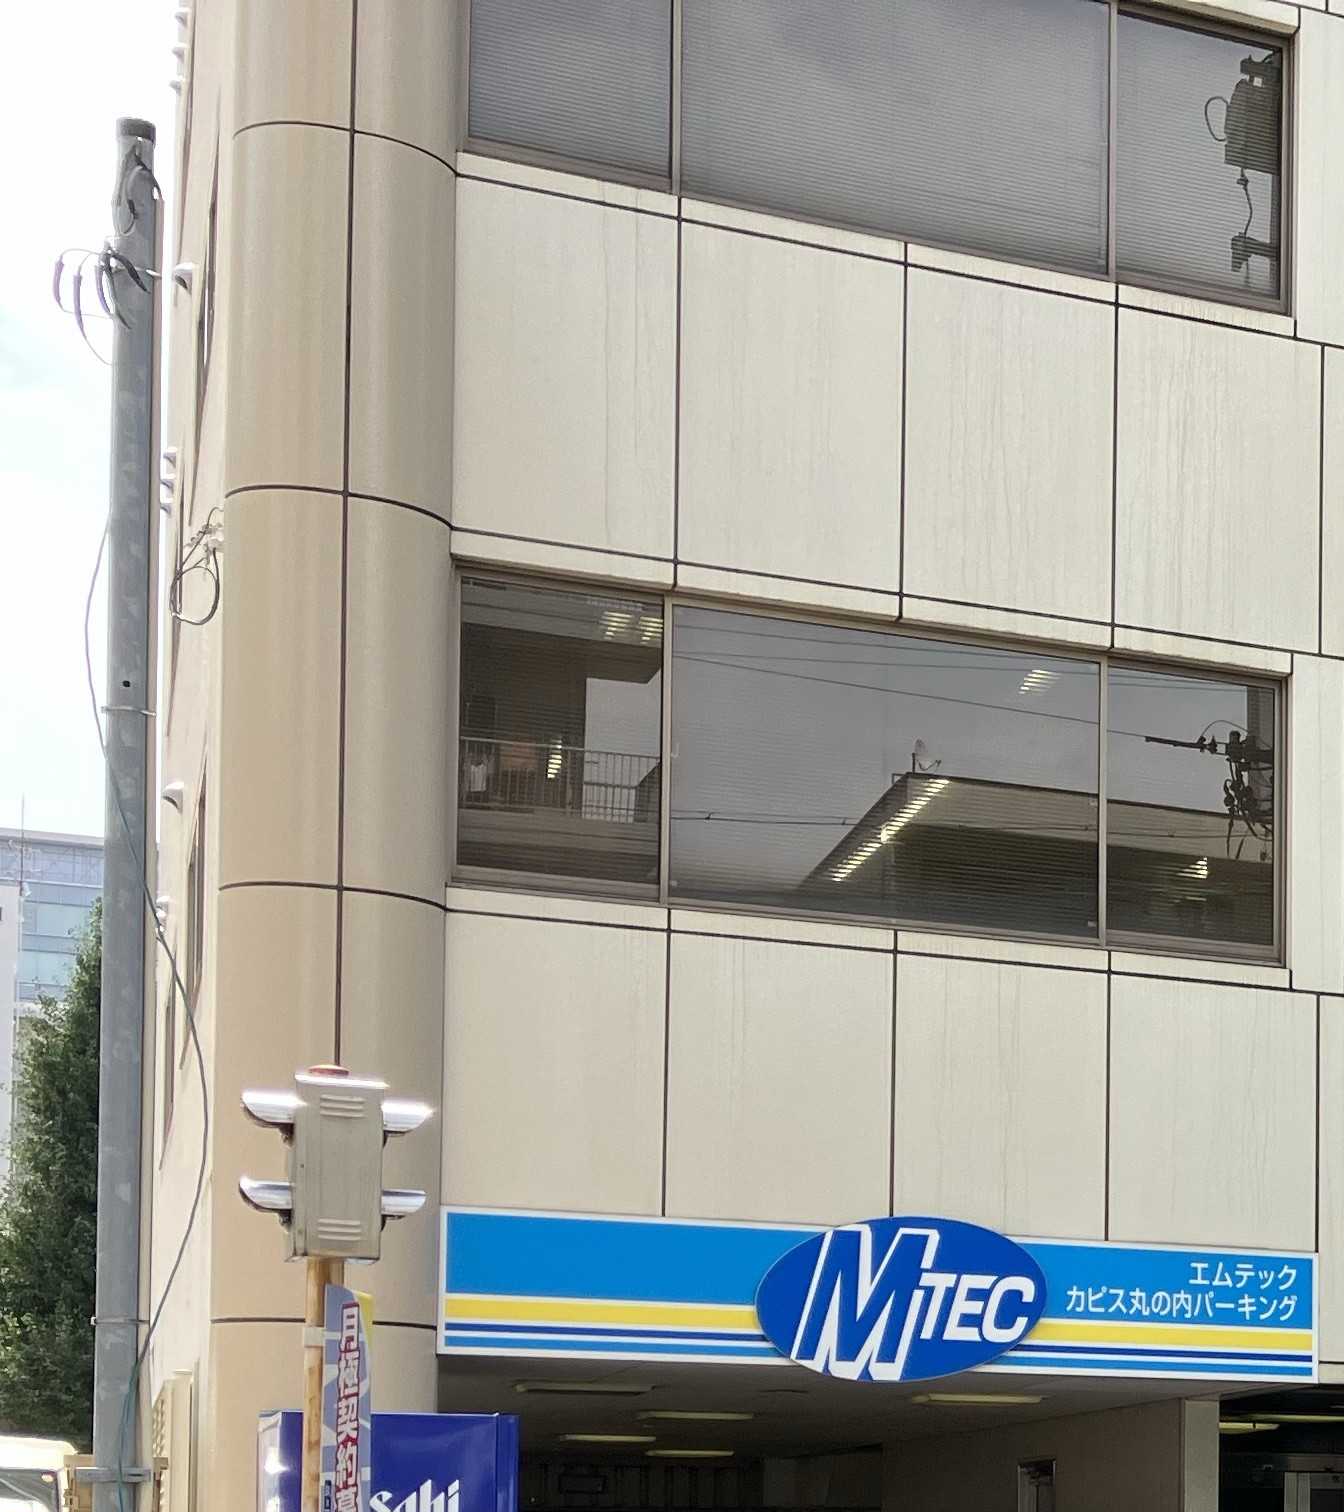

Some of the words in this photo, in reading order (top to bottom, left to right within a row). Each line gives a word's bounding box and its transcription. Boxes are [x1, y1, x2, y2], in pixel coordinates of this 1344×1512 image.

[1189, 1262, 1298, 1290] エムテック
[1066, 1285, 1298, 1321] カピス丸の内パーキング
